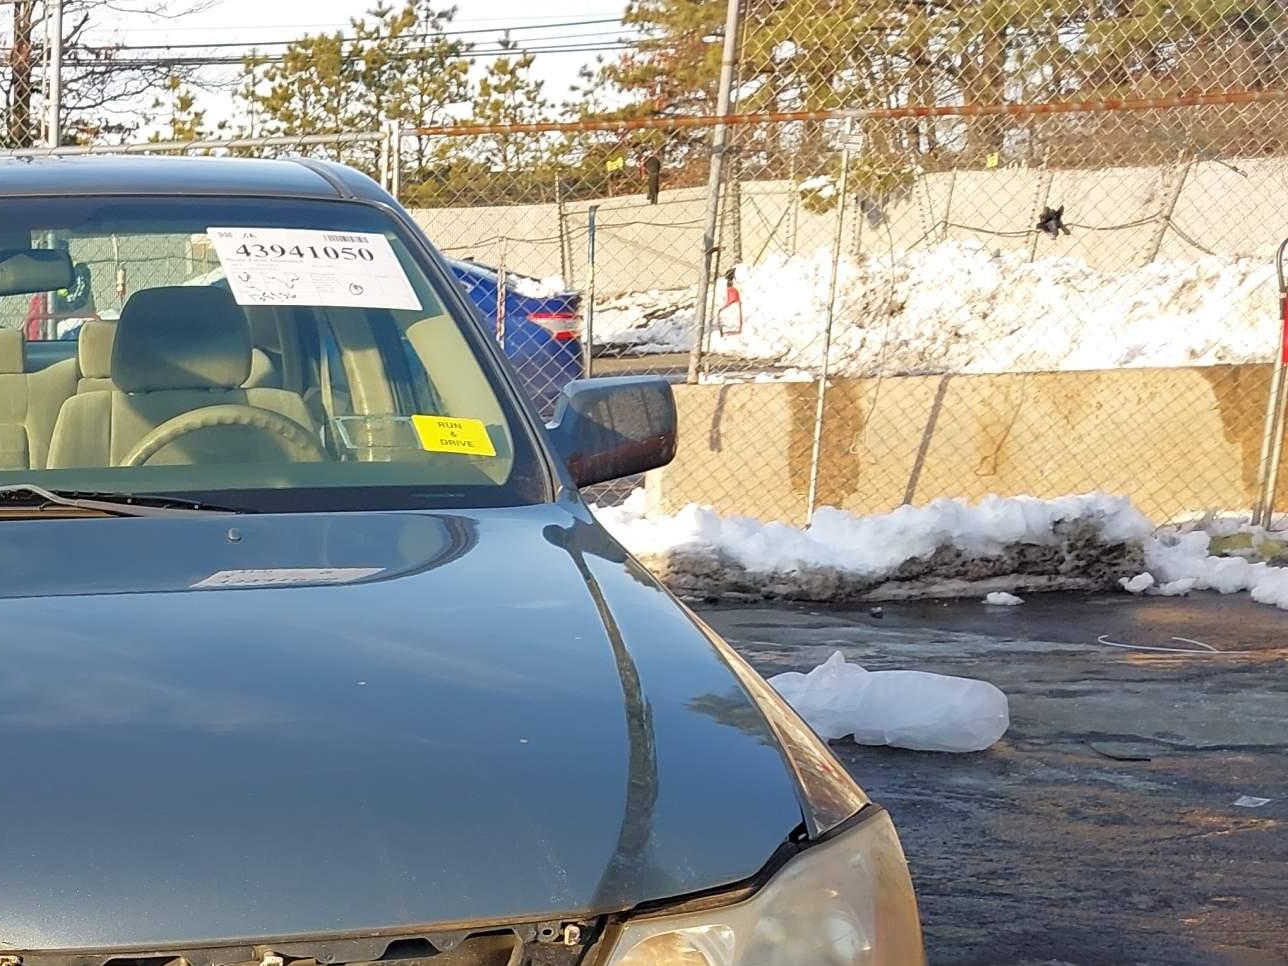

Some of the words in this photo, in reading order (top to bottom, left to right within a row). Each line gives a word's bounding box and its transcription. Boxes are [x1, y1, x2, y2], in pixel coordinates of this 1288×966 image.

[235, 243, 374, 262] 43941050
[437, 421, 462, 429] RUN
[450, 430, 457, 438] &
[440, 438, 475, 448] DRIVE
